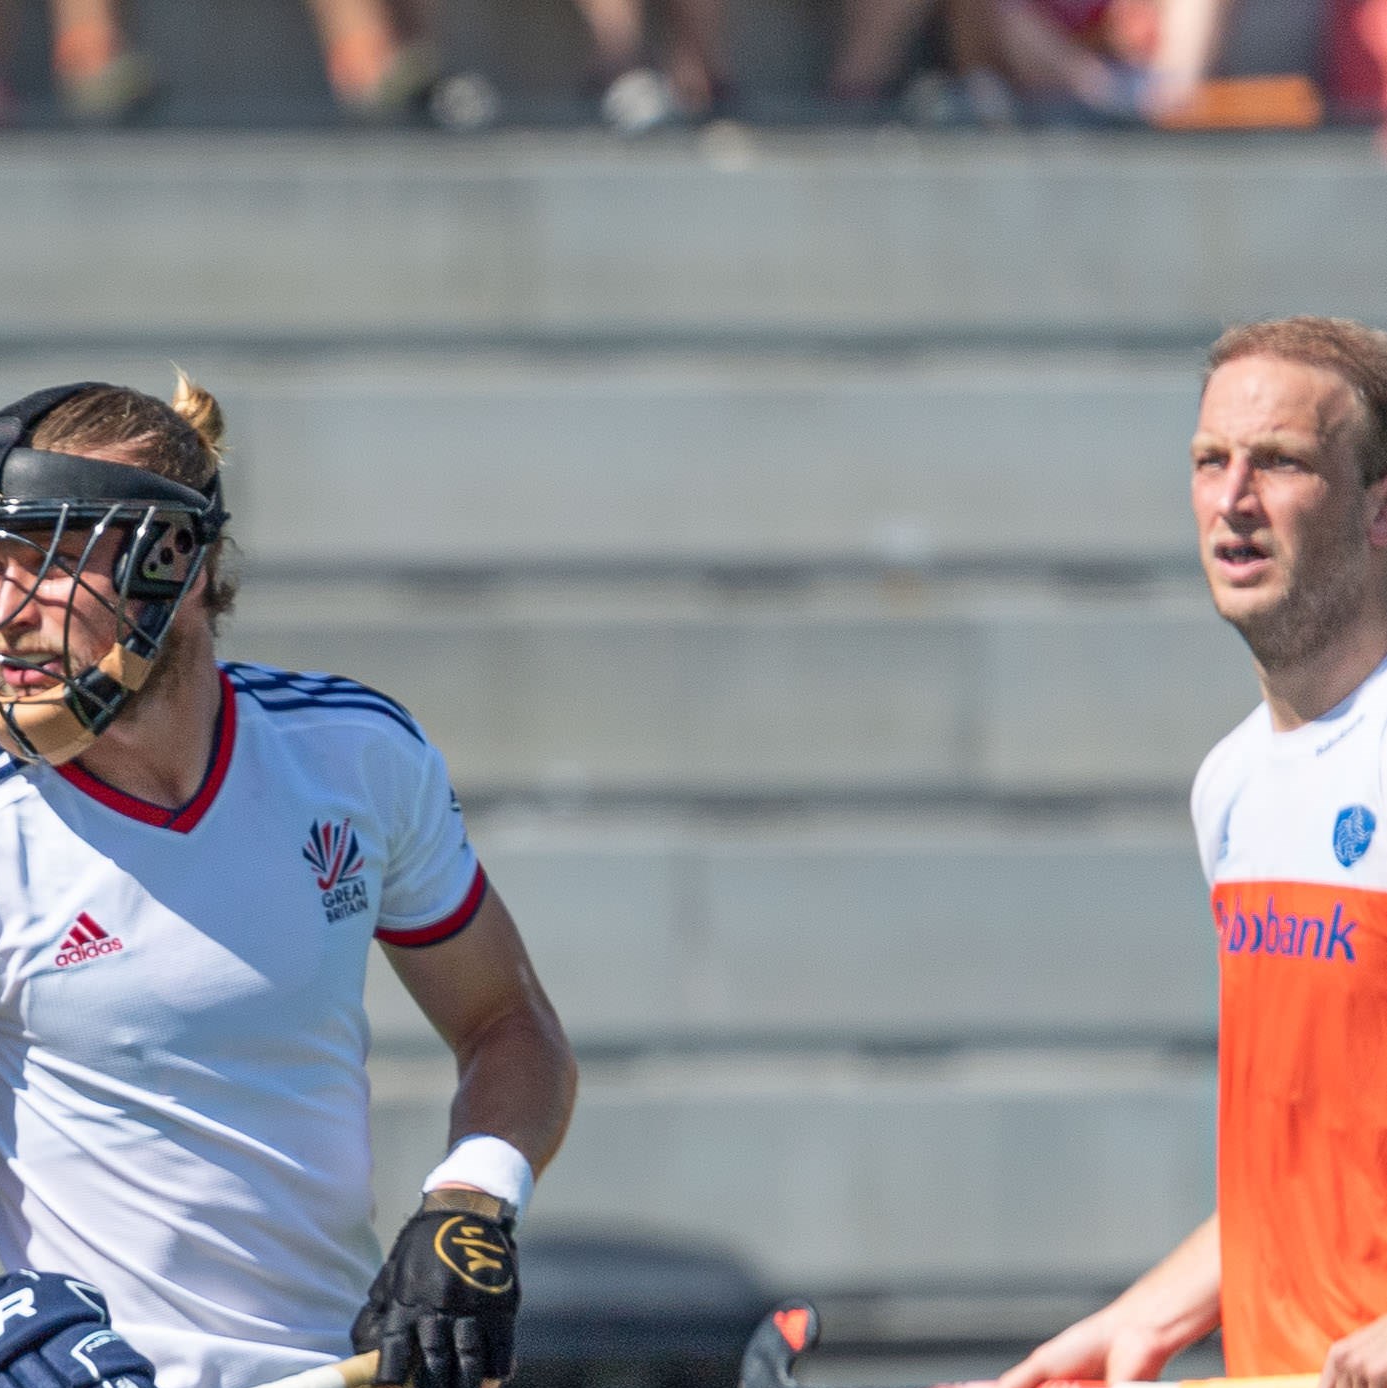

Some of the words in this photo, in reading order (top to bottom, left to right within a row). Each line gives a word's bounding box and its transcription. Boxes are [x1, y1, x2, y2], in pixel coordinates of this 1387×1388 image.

[321, 881, 367, 909] GREAT
[325, 898, 369, 924] BRITAIN
[55, 938, 123, 967] adidas
